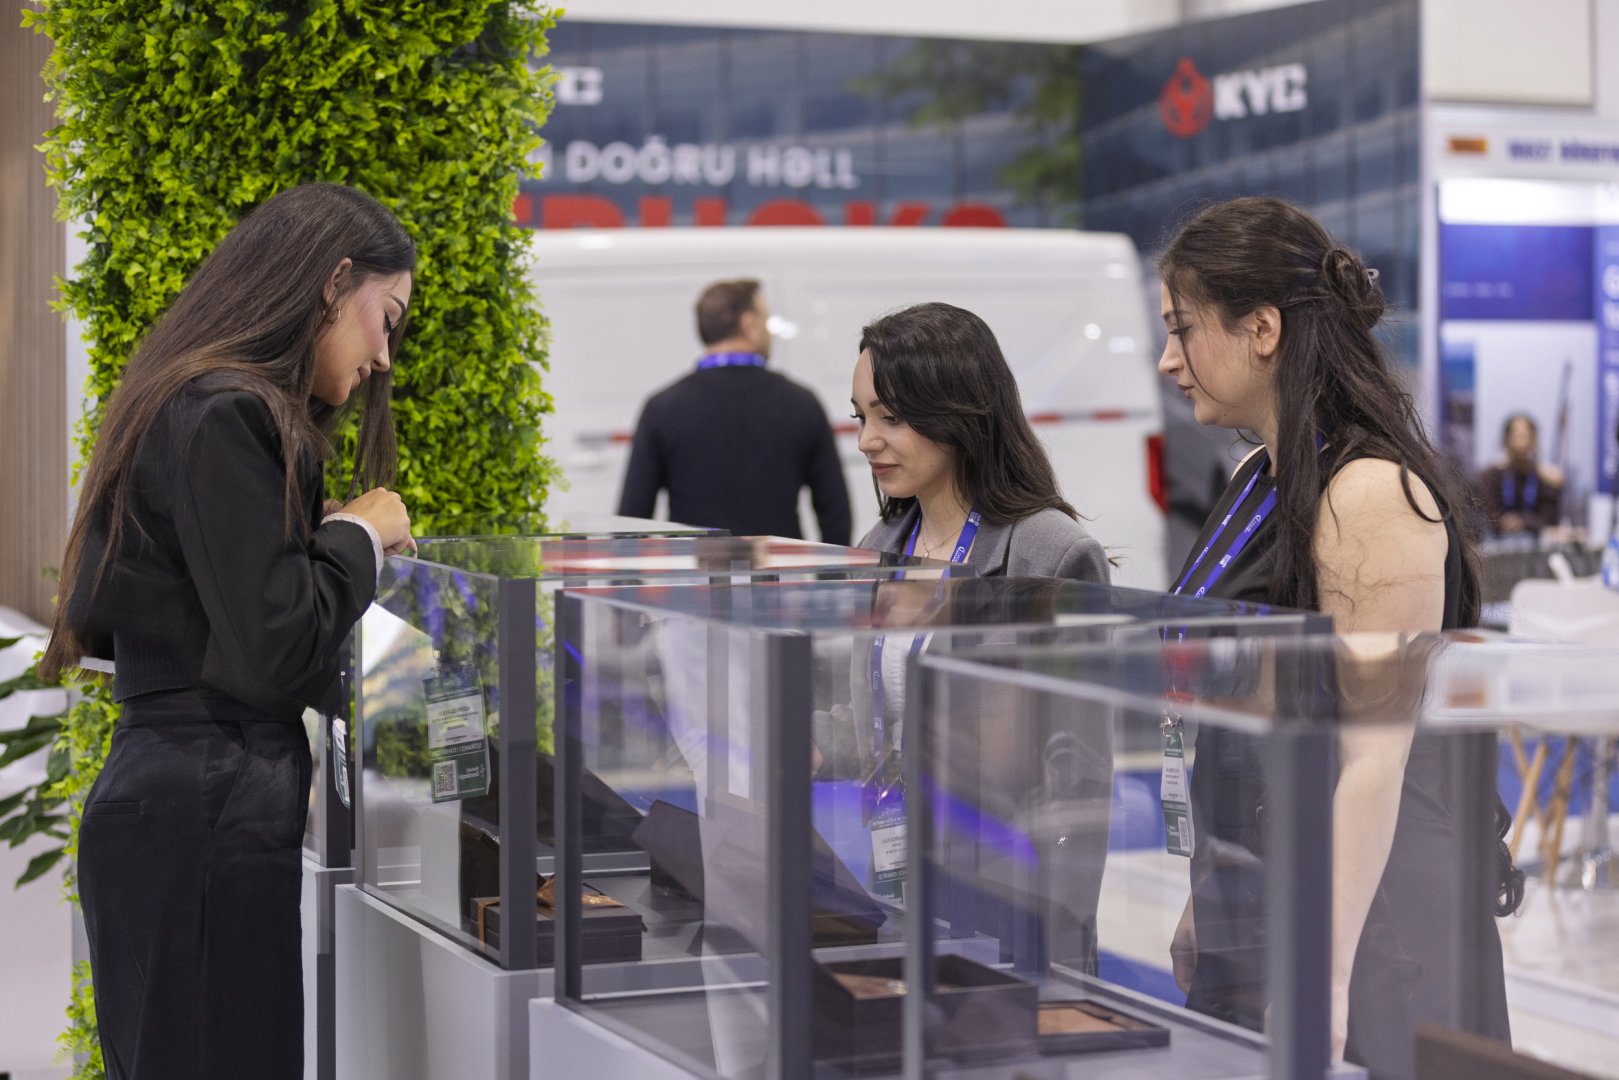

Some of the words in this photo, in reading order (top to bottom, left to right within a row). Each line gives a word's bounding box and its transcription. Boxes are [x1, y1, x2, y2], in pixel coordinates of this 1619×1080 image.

[1214, 63, 1307, 120] KYC
[566, 134, 736, 187] DOĞRU
[746, 144, 859, 190] HƏLL
